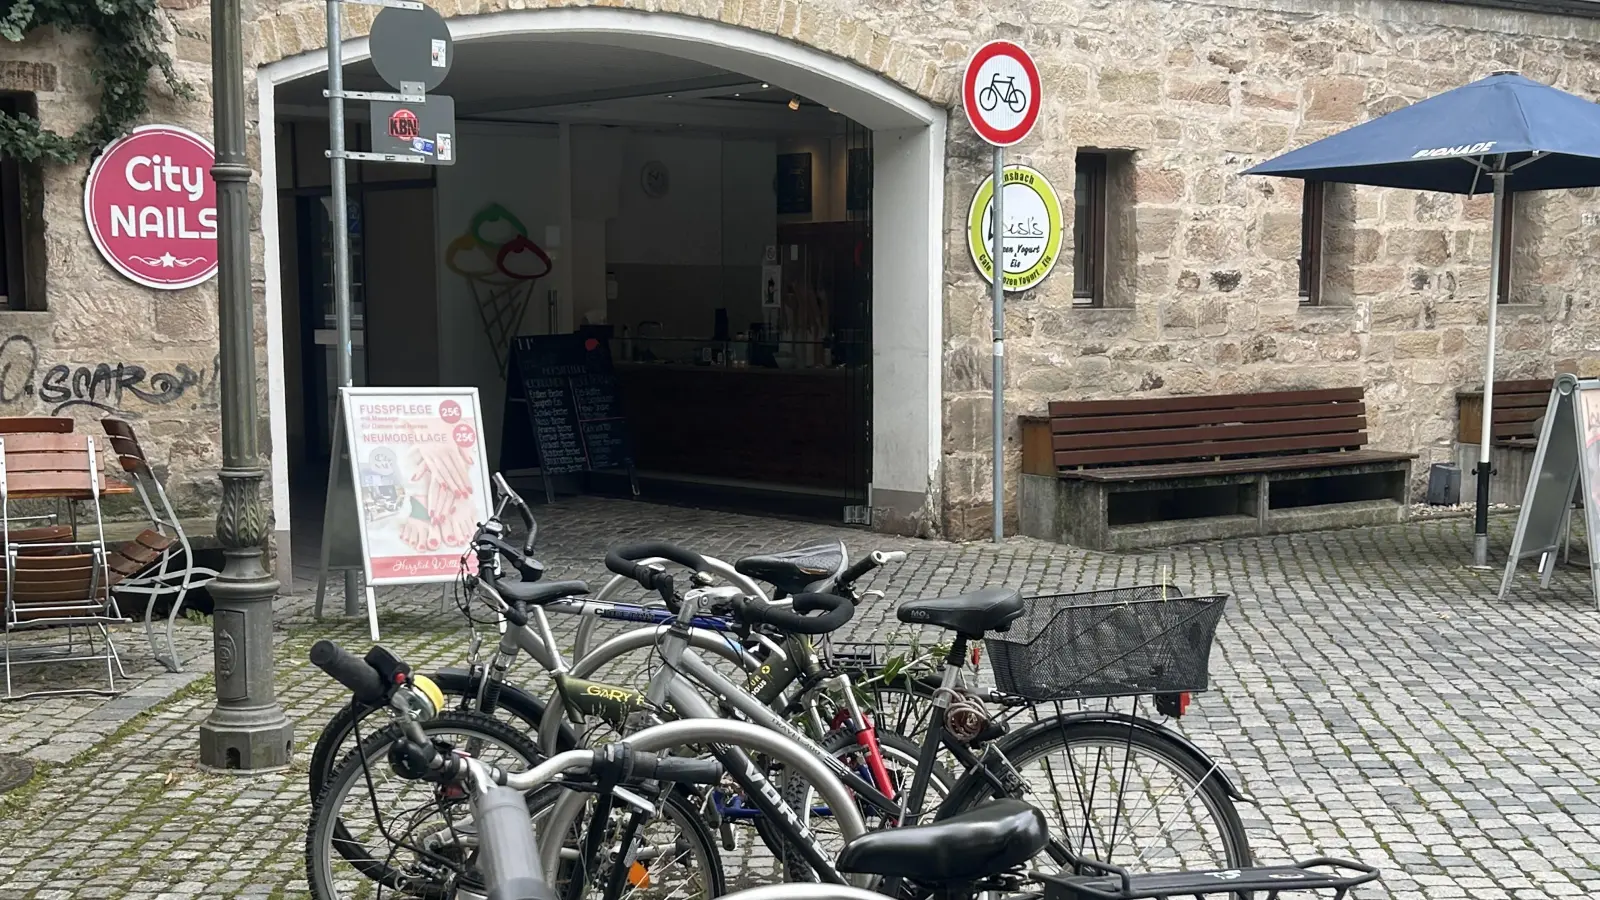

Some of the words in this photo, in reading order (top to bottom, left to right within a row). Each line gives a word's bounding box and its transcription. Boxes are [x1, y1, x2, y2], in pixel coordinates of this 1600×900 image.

[390, 118, 418, 136] KBN
[125, 154, 204, 202] City
[1003, 171, 1035, 185] nsbach
[110, 204, 218, 239] NAILS
[1016, 244, 1040, 257] Yogurt
[1009, 258, 1021, 268] Eis
[1018, 269, 1041, 286] Yogurt
[360, 404, 433, 415] FUSSPFLEGE
[440, 406, 461, 418] 25€
[363, 433, 448, 443] NEUMODELLAGE
[455, 432, 475, 442] 25€
[587, 685, 633, 703] GARY
